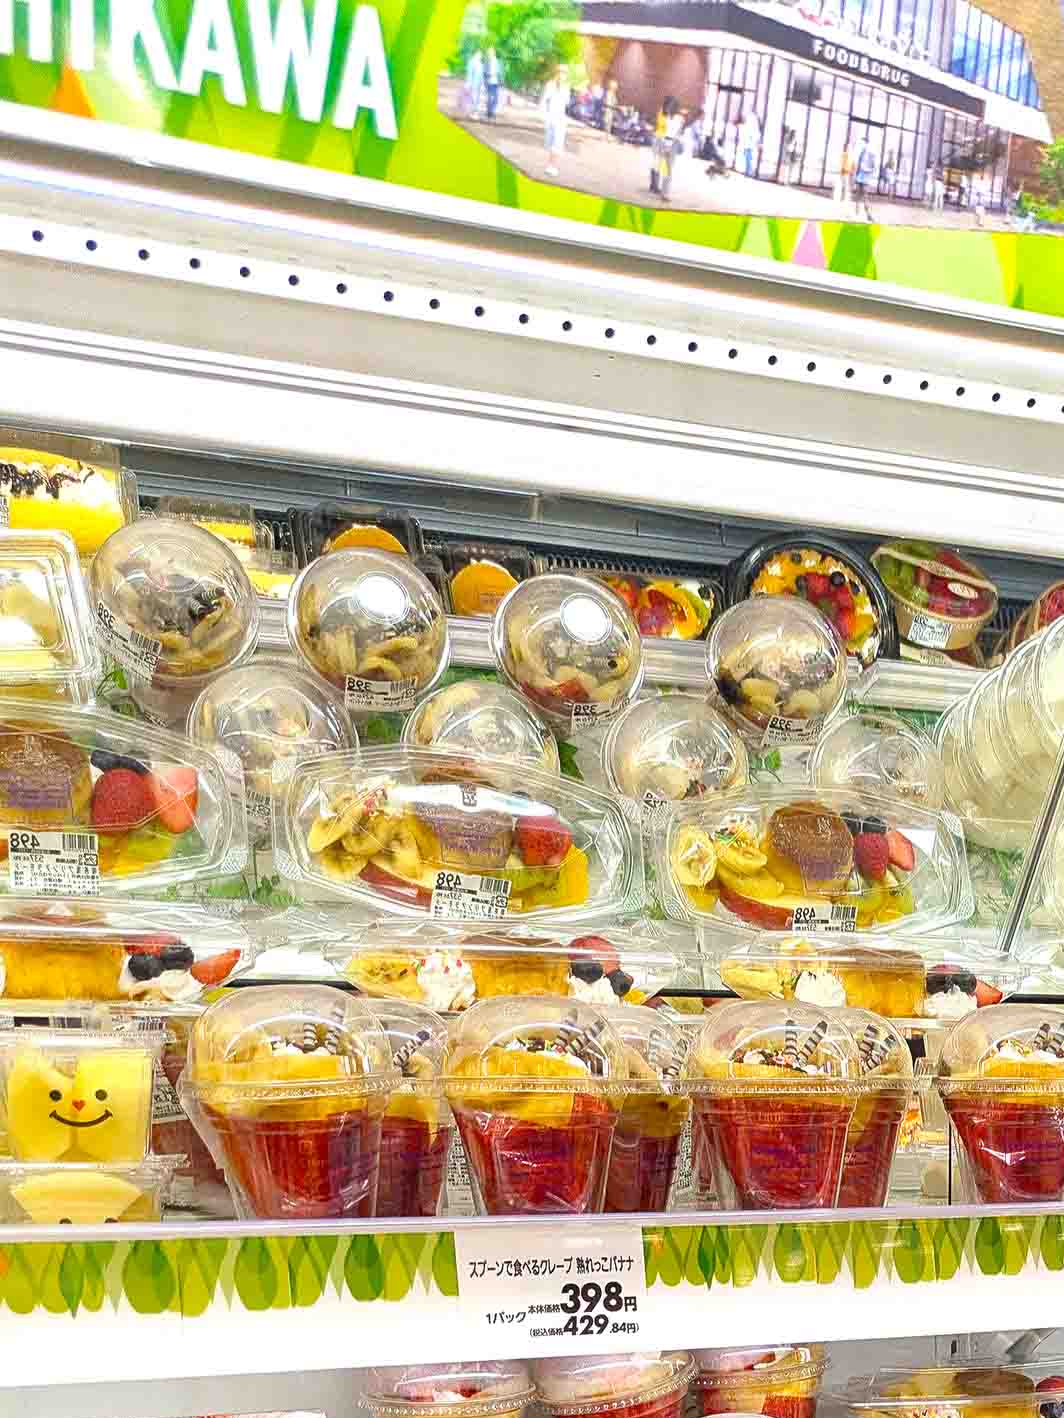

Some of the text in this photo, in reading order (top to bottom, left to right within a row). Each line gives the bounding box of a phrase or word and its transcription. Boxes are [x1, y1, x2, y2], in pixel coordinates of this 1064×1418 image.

[812, 37, 912, 88] FOOD&DRUG
[469, 1255, 635, 1279] スプーンで食べるクレープ 熟れっこバナナ
[486, 1311, 527, 1325] 1パック
